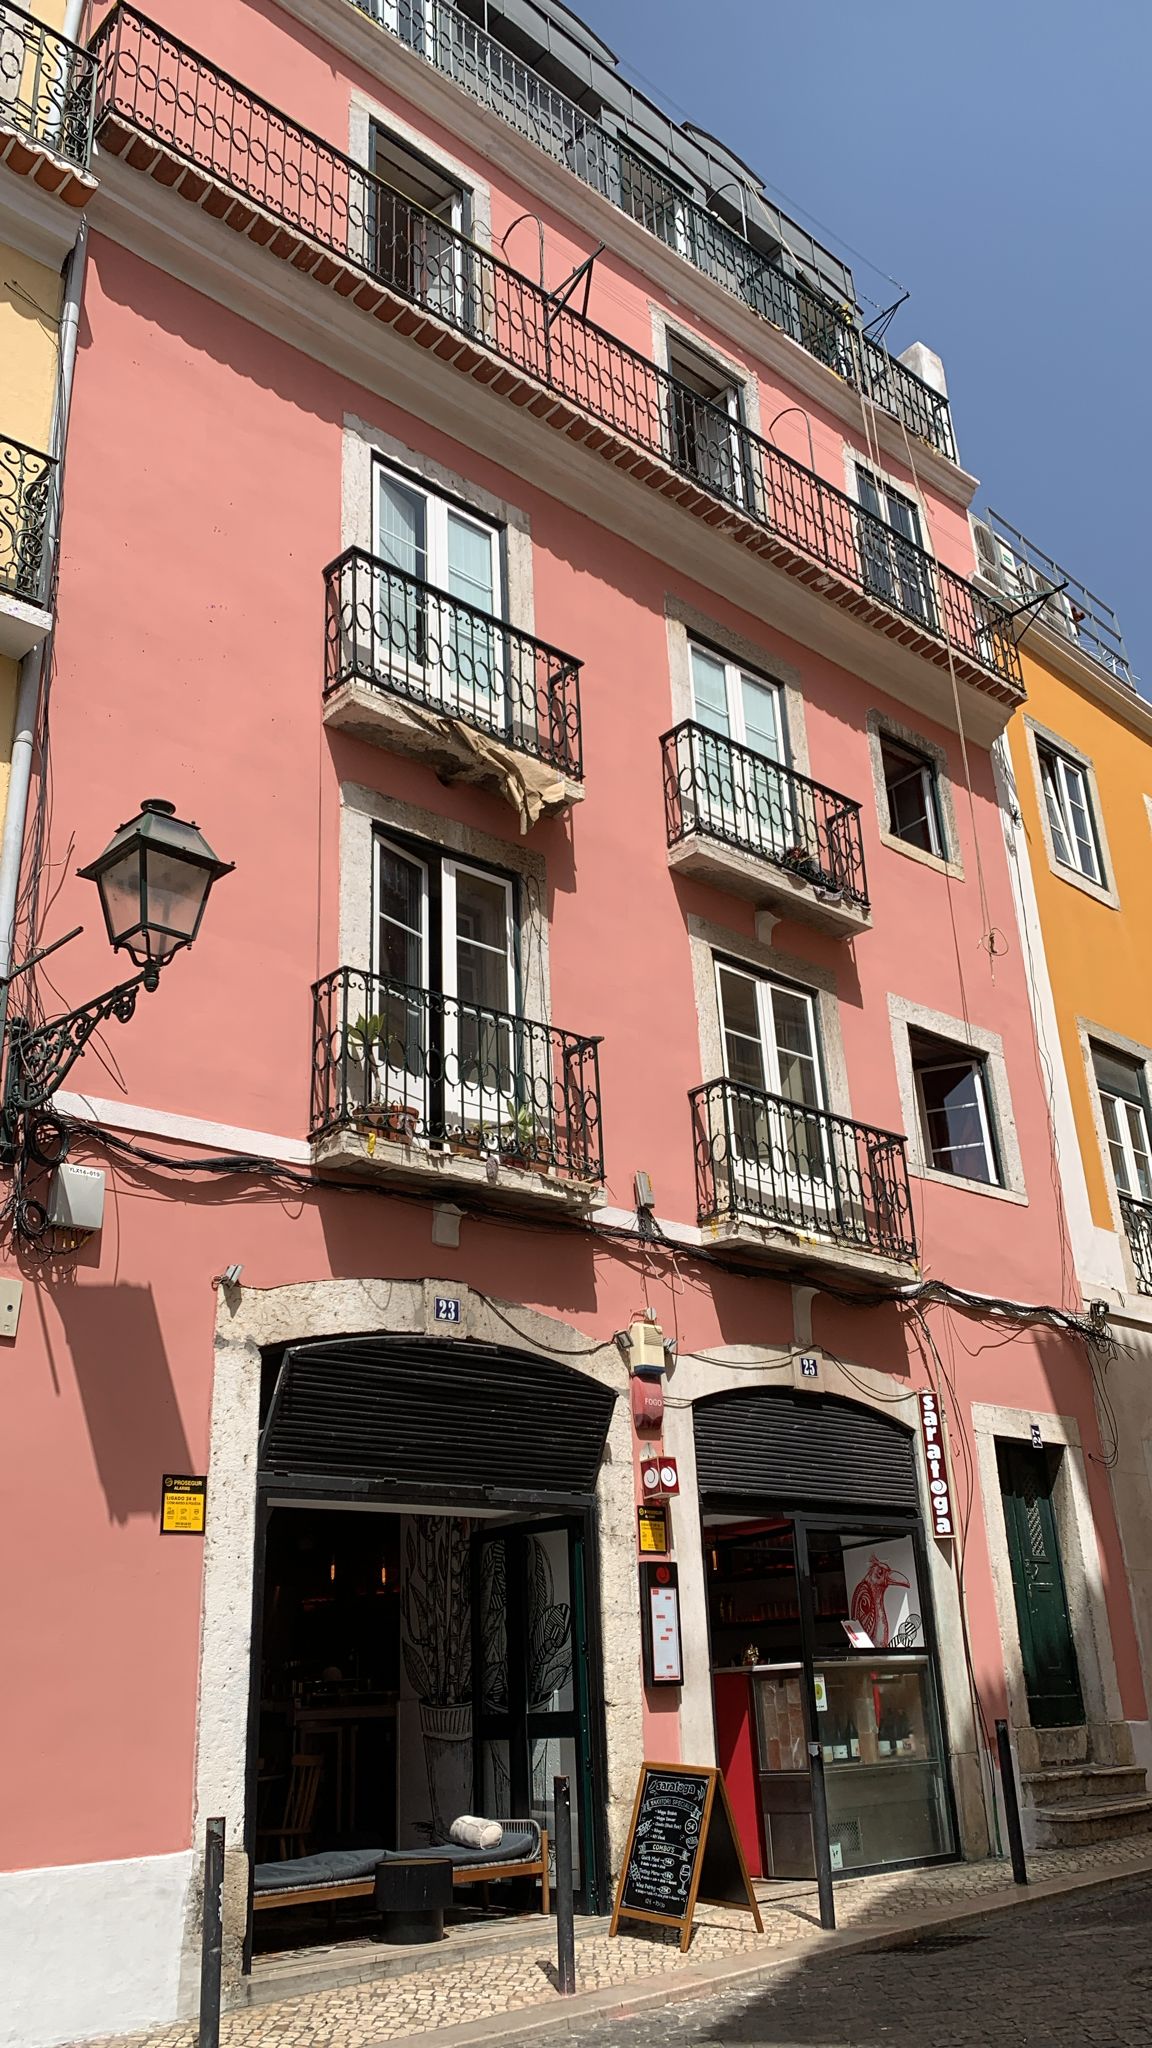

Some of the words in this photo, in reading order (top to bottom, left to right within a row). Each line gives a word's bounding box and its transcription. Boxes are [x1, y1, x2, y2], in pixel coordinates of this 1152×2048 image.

[439, 1300, 455, 1320] 23
[803, 1359, 815, 1375] 25
[644, 1397, 662, 1406] FOGO
[922, 1395, 951, 1533] saratoga
[656, 1781, 696, 1794] saratoga
[652, 1844, 675, 1853] COMBO'S
